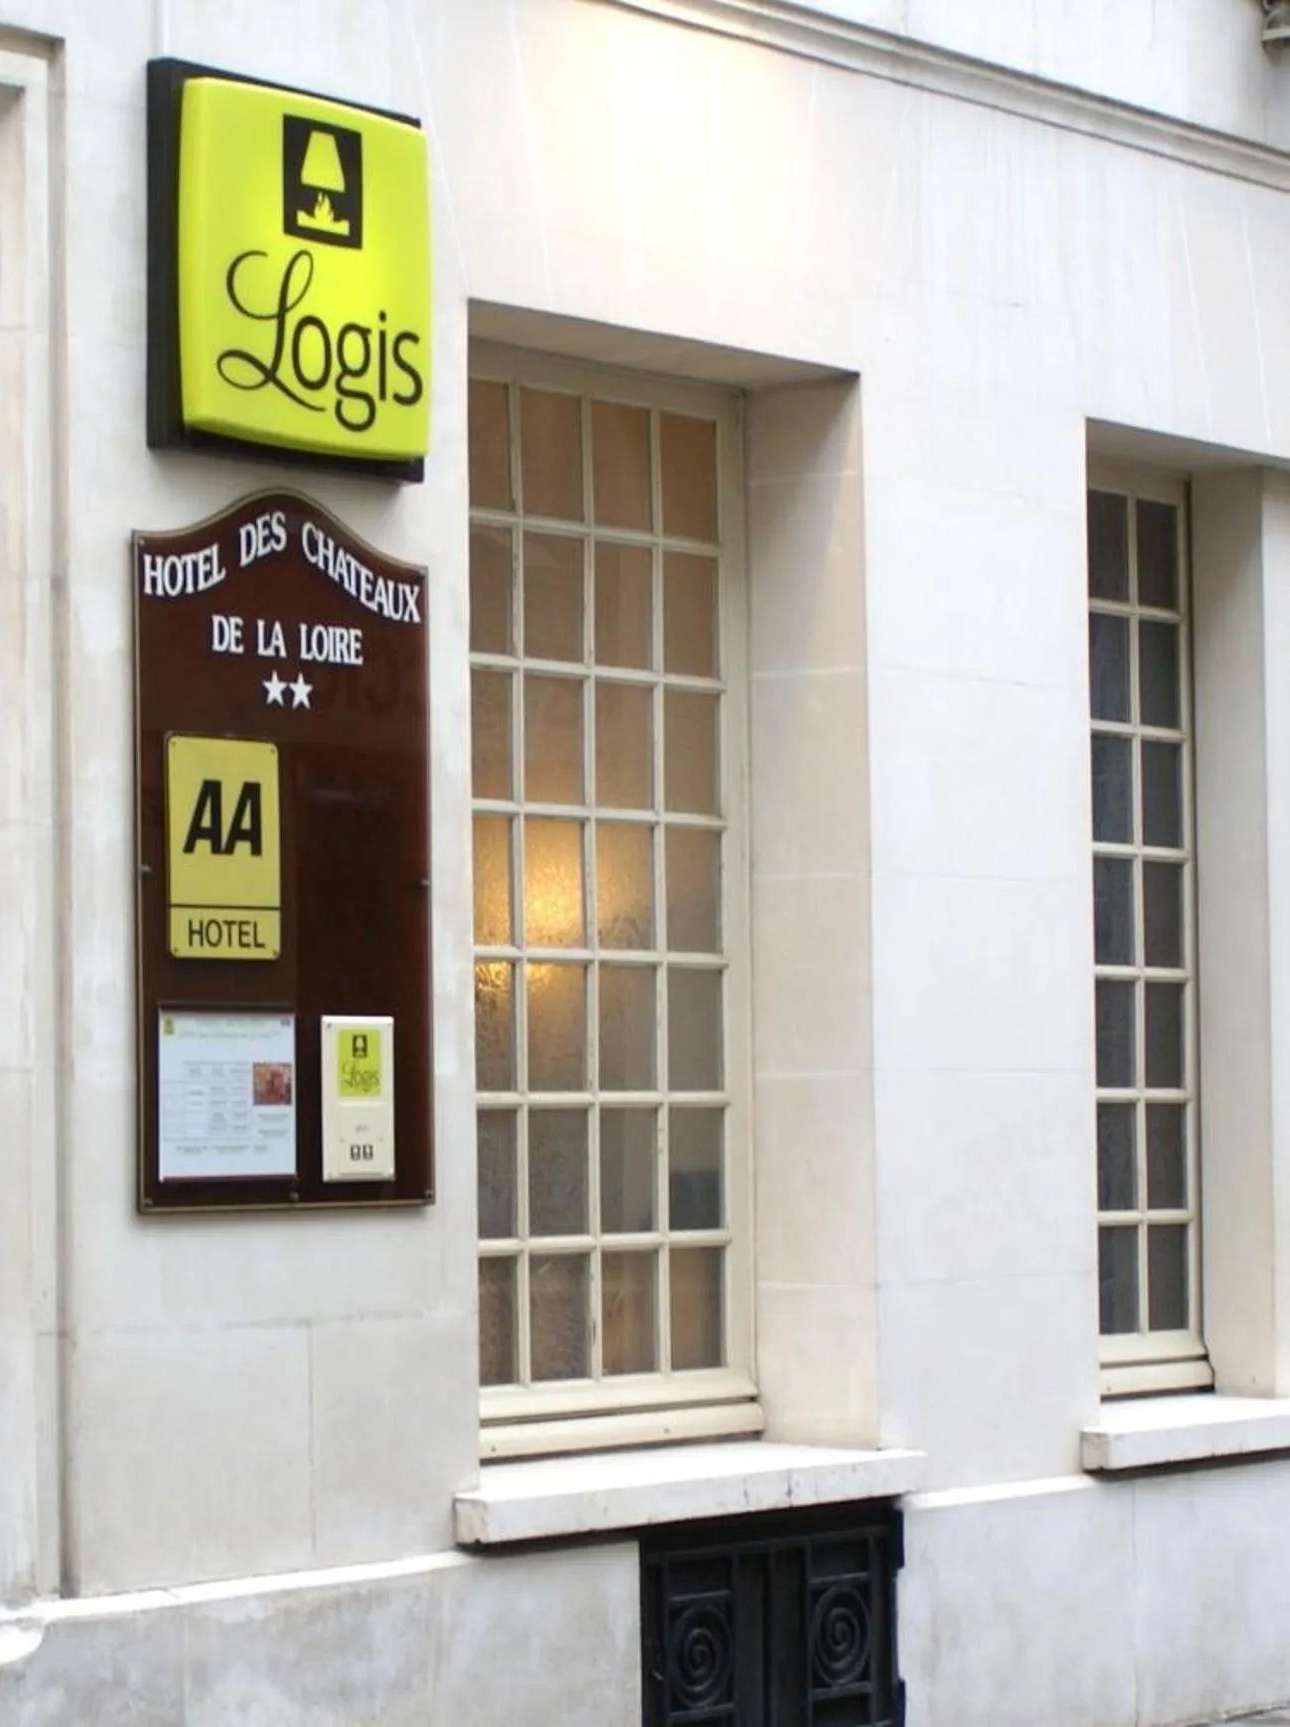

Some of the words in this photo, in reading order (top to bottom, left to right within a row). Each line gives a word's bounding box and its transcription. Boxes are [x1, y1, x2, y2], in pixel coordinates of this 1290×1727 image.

[216, 249, 423, 432] Logis
[143, 542, 227, 597] HOTEL
[239, 511, 287, 567] DES
[301, 521, 422, 623] CHATEAUX
[211, 614, 244, 654] DE
[257, 618, 287, 658] LA
[300, 622, 364, 665] LOIRE
[182, 779, 263, 857] AA
[187, 918, 266, 949] HOTEL
